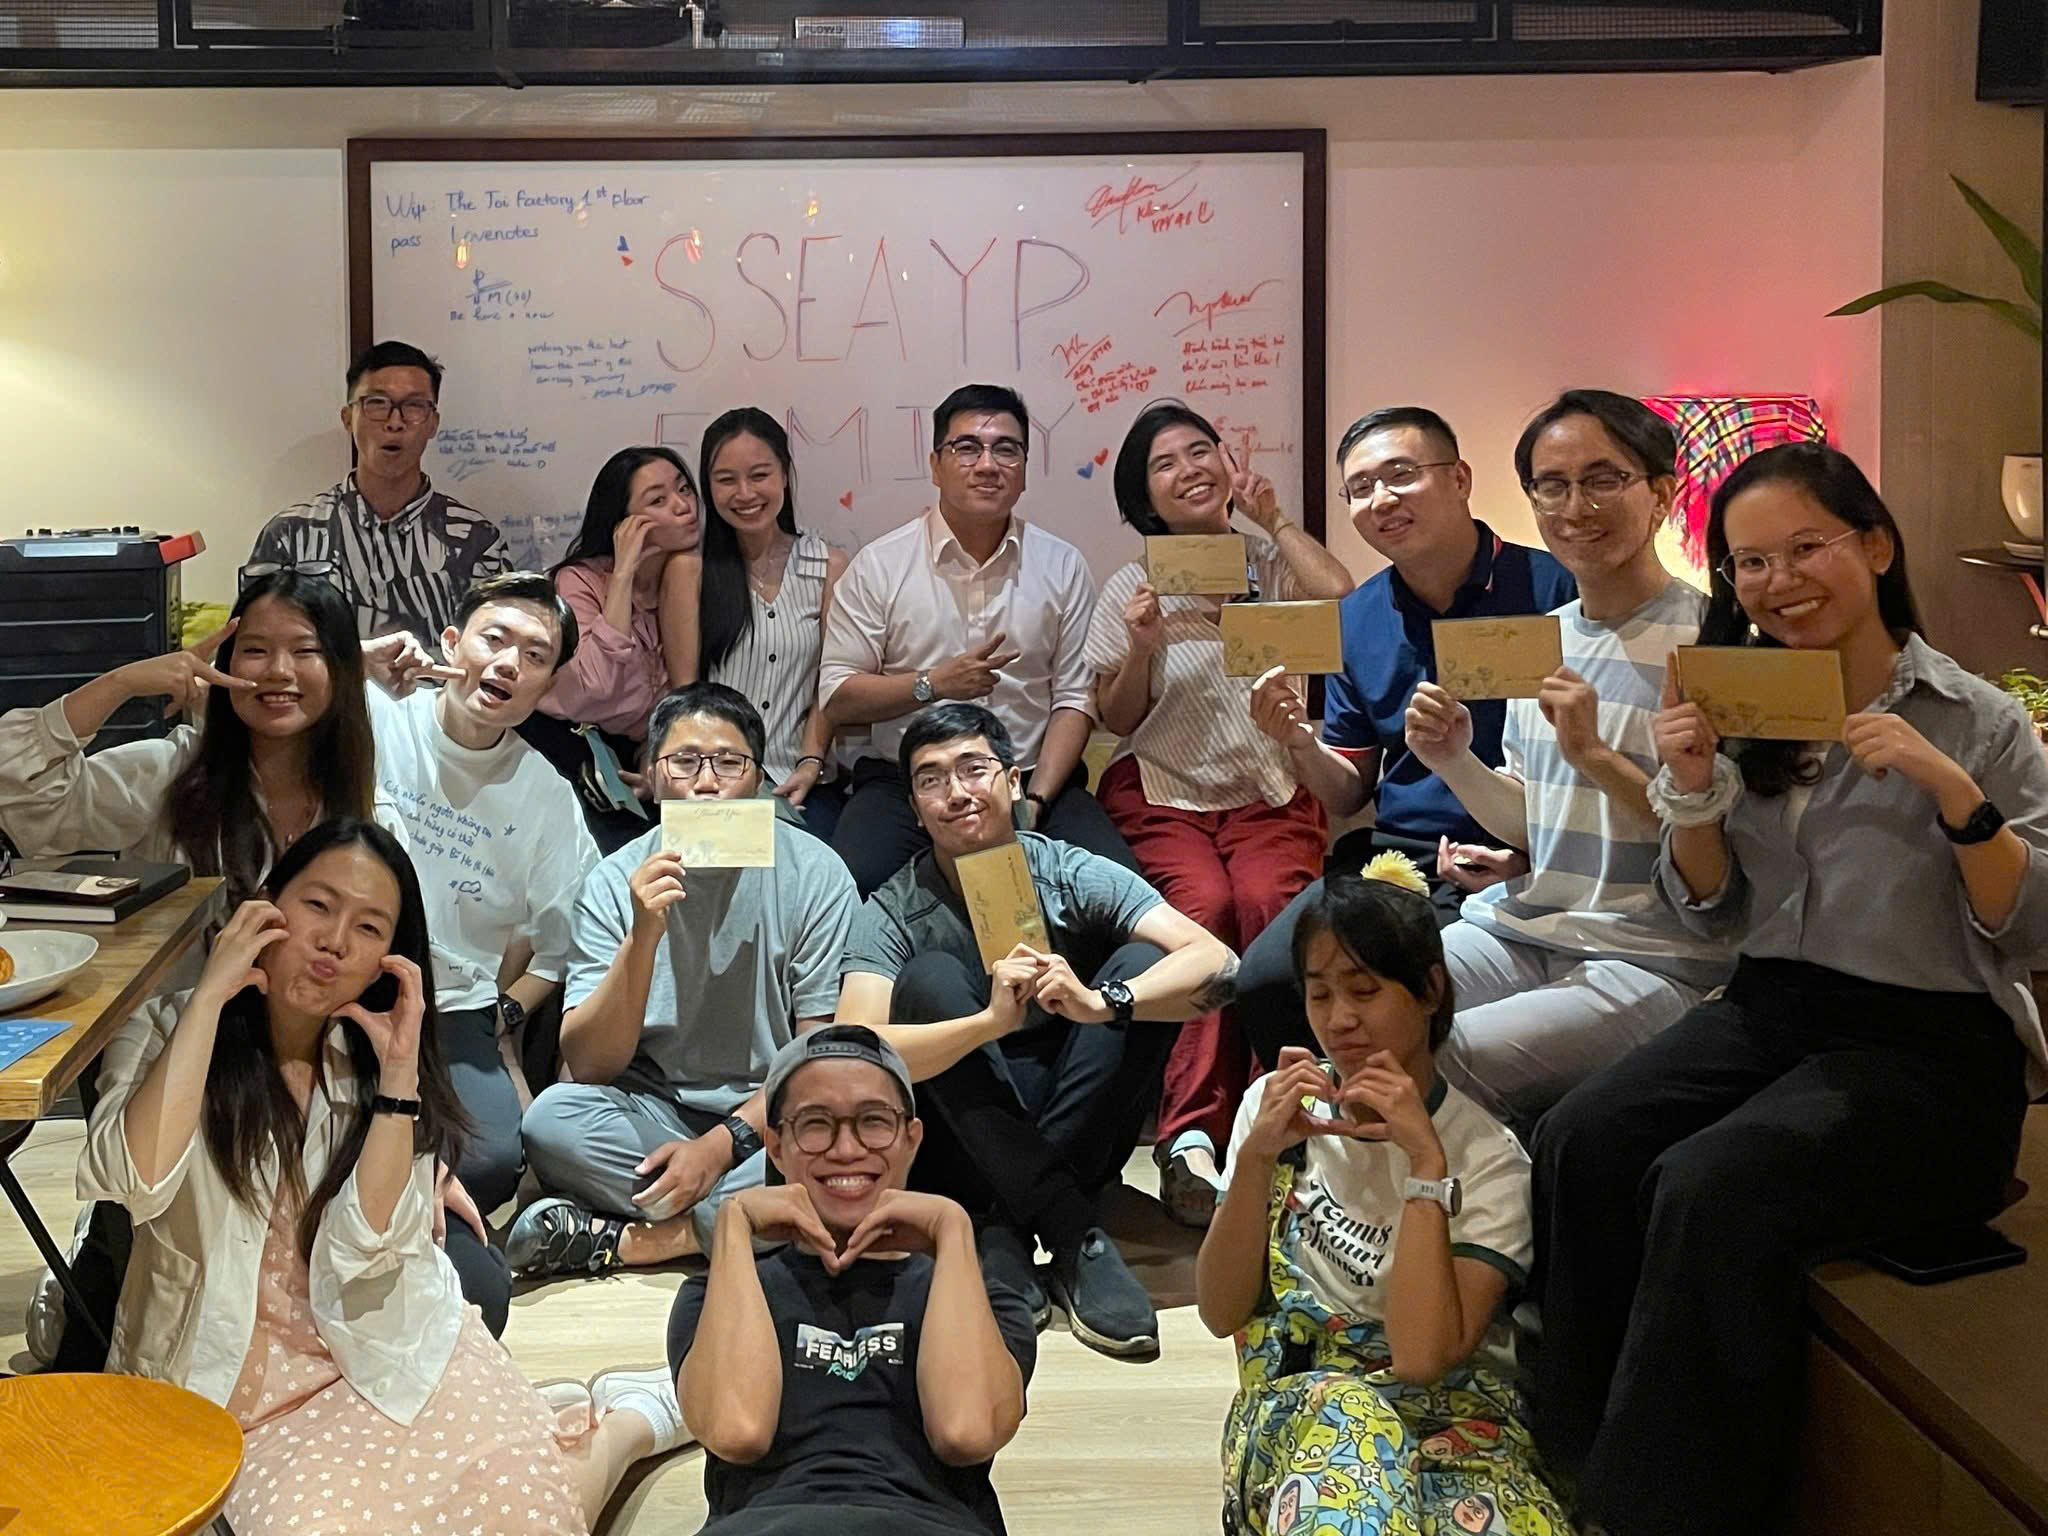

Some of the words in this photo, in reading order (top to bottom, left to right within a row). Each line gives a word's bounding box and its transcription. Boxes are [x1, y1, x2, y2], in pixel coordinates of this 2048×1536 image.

[446, 190, 477, 212] The
[391, 234, 423, 258] pass
[655, 231, 1091, 373] SSEAYP
[654, 402, 1076, 482] FMIY
[806, 1336, 897, 1368] FEARLESS
